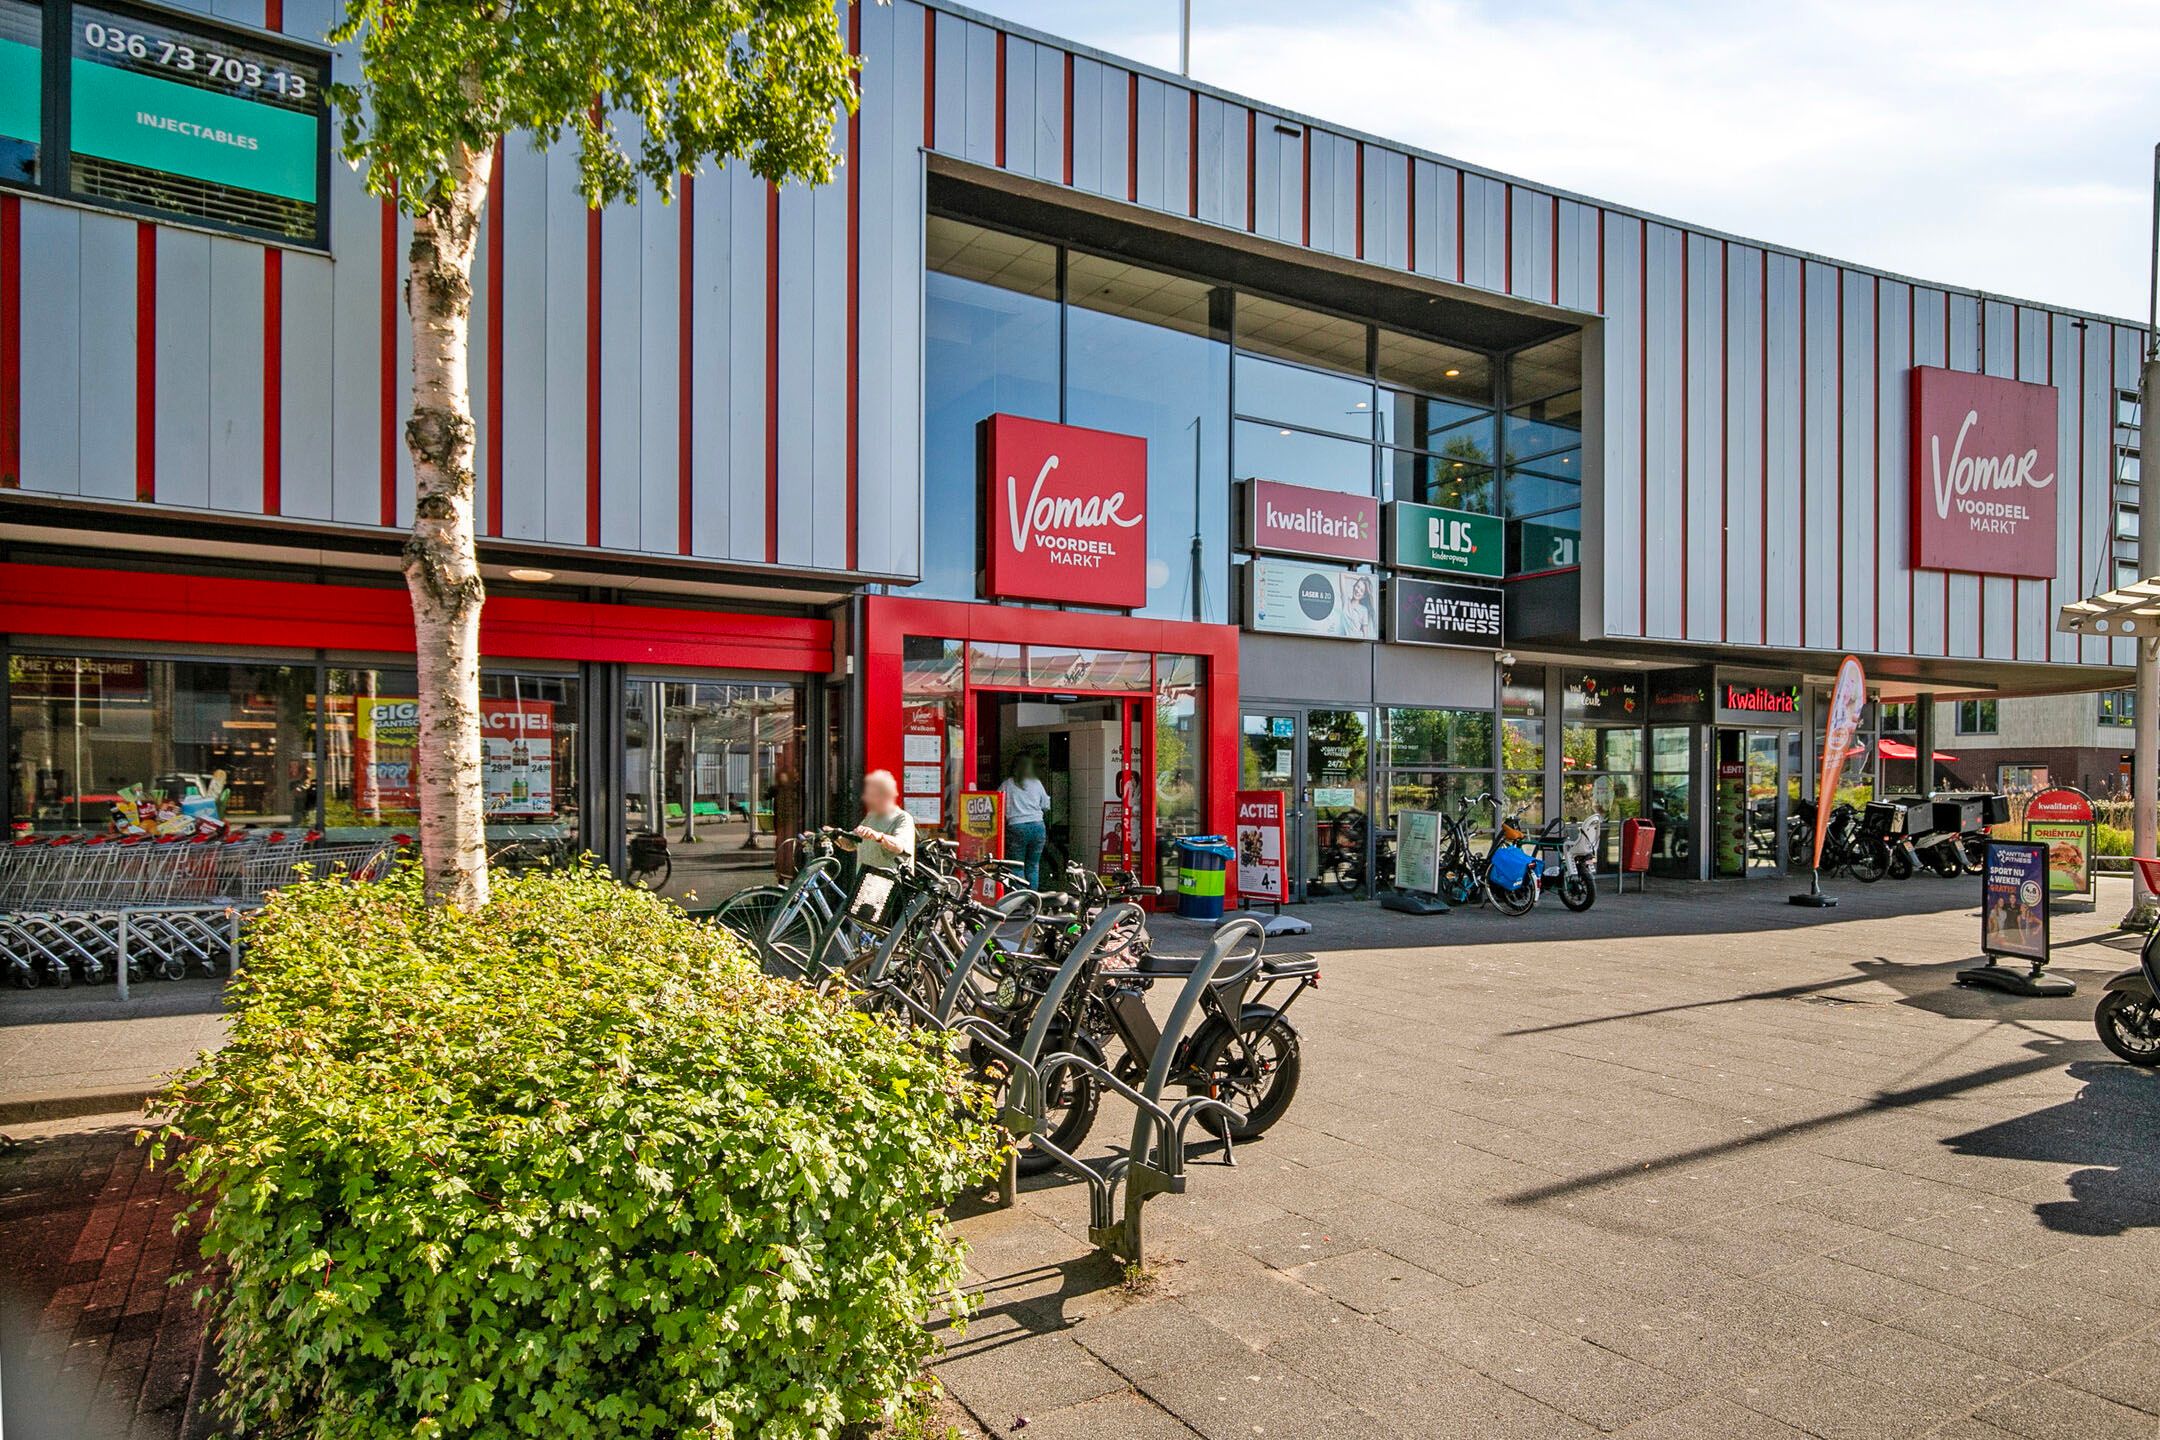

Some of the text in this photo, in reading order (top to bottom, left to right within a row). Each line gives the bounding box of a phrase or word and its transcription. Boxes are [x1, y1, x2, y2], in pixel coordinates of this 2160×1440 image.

[85, 22, 307, 98] 036 73 703 13
[136, 111, 259, 150] INJECTABLES
[1956, 498, 2030, 520] VOORDEEL
[1266, 501, 1359, 539] kwalitaria
[1970, 517, 2017, 535] MARKT
[1428, 517, 1473, 553] BLOS
[1034, 534, 1116, 556] VOORDEEL
[1050, 551, 1102, 568] MARKT
[1301, 590, 1320, 598] LASER
[1423, 597, 1500, 621] ANYTIME
[1425, 614, 1500, 635] FITNESS
[1728, 683, 1793, 713] kwalitaria
[370, 702, 419, 721] GIG
[480, 712, 548, 730] ACTIE!
[1327, 760, 1343, 769] 24/7
[968, 796, 994, 814] GIGA
[1240, 803, 1278, 819] ACTIE!
[1990, 866, 2025, 877] SPORT NU
[1994, 876, 2020, 886] WEKEN
